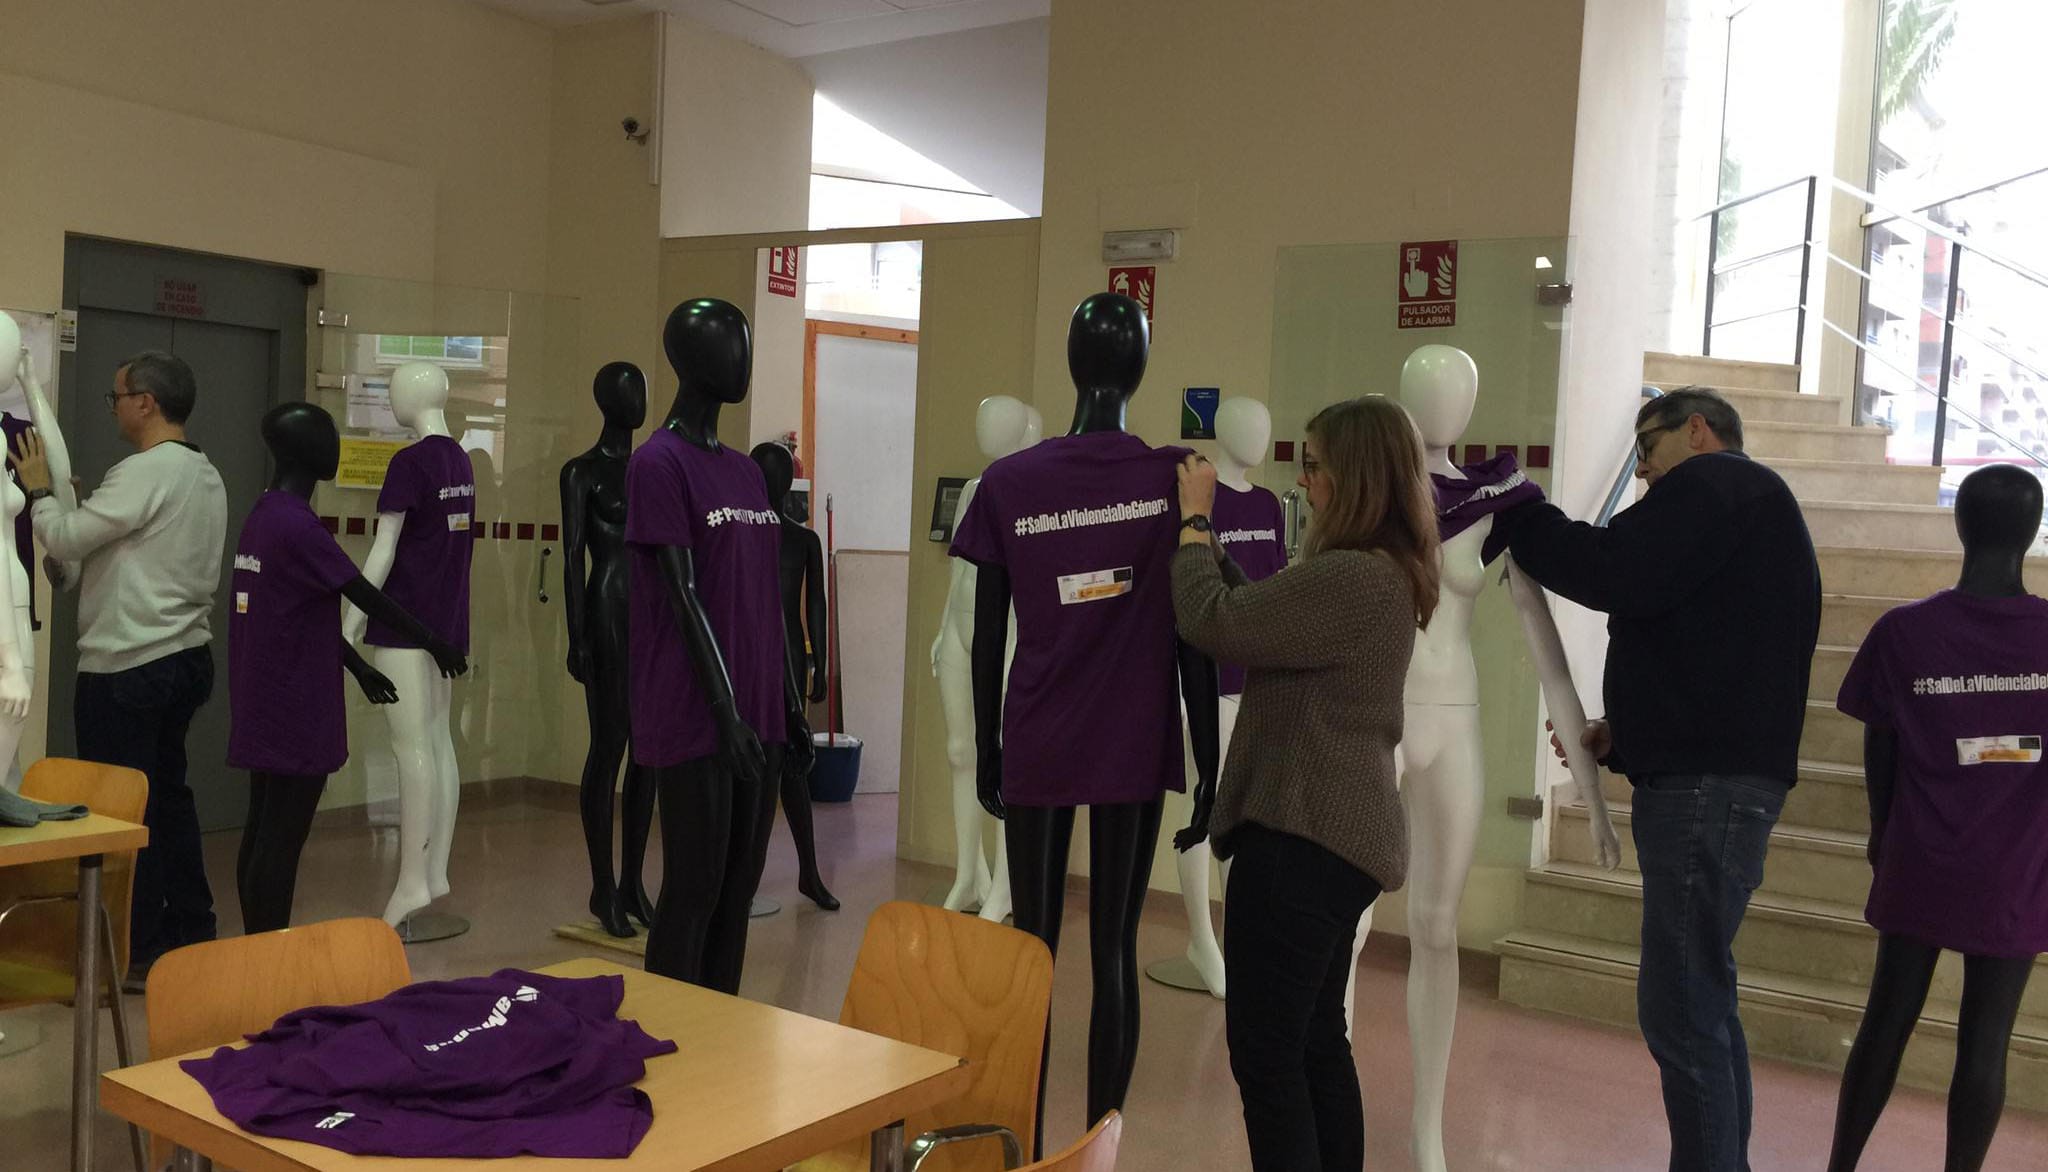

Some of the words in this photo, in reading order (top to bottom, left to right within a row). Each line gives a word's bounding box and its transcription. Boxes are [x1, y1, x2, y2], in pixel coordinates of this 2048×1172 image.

[770, 281, 795, 292] EXTINTOR
[1403, 305, 1451, 315] PULSADOR
[1401, 317, 1413, 326] DE
[1415, 315, 1452, 325] ALARMA
